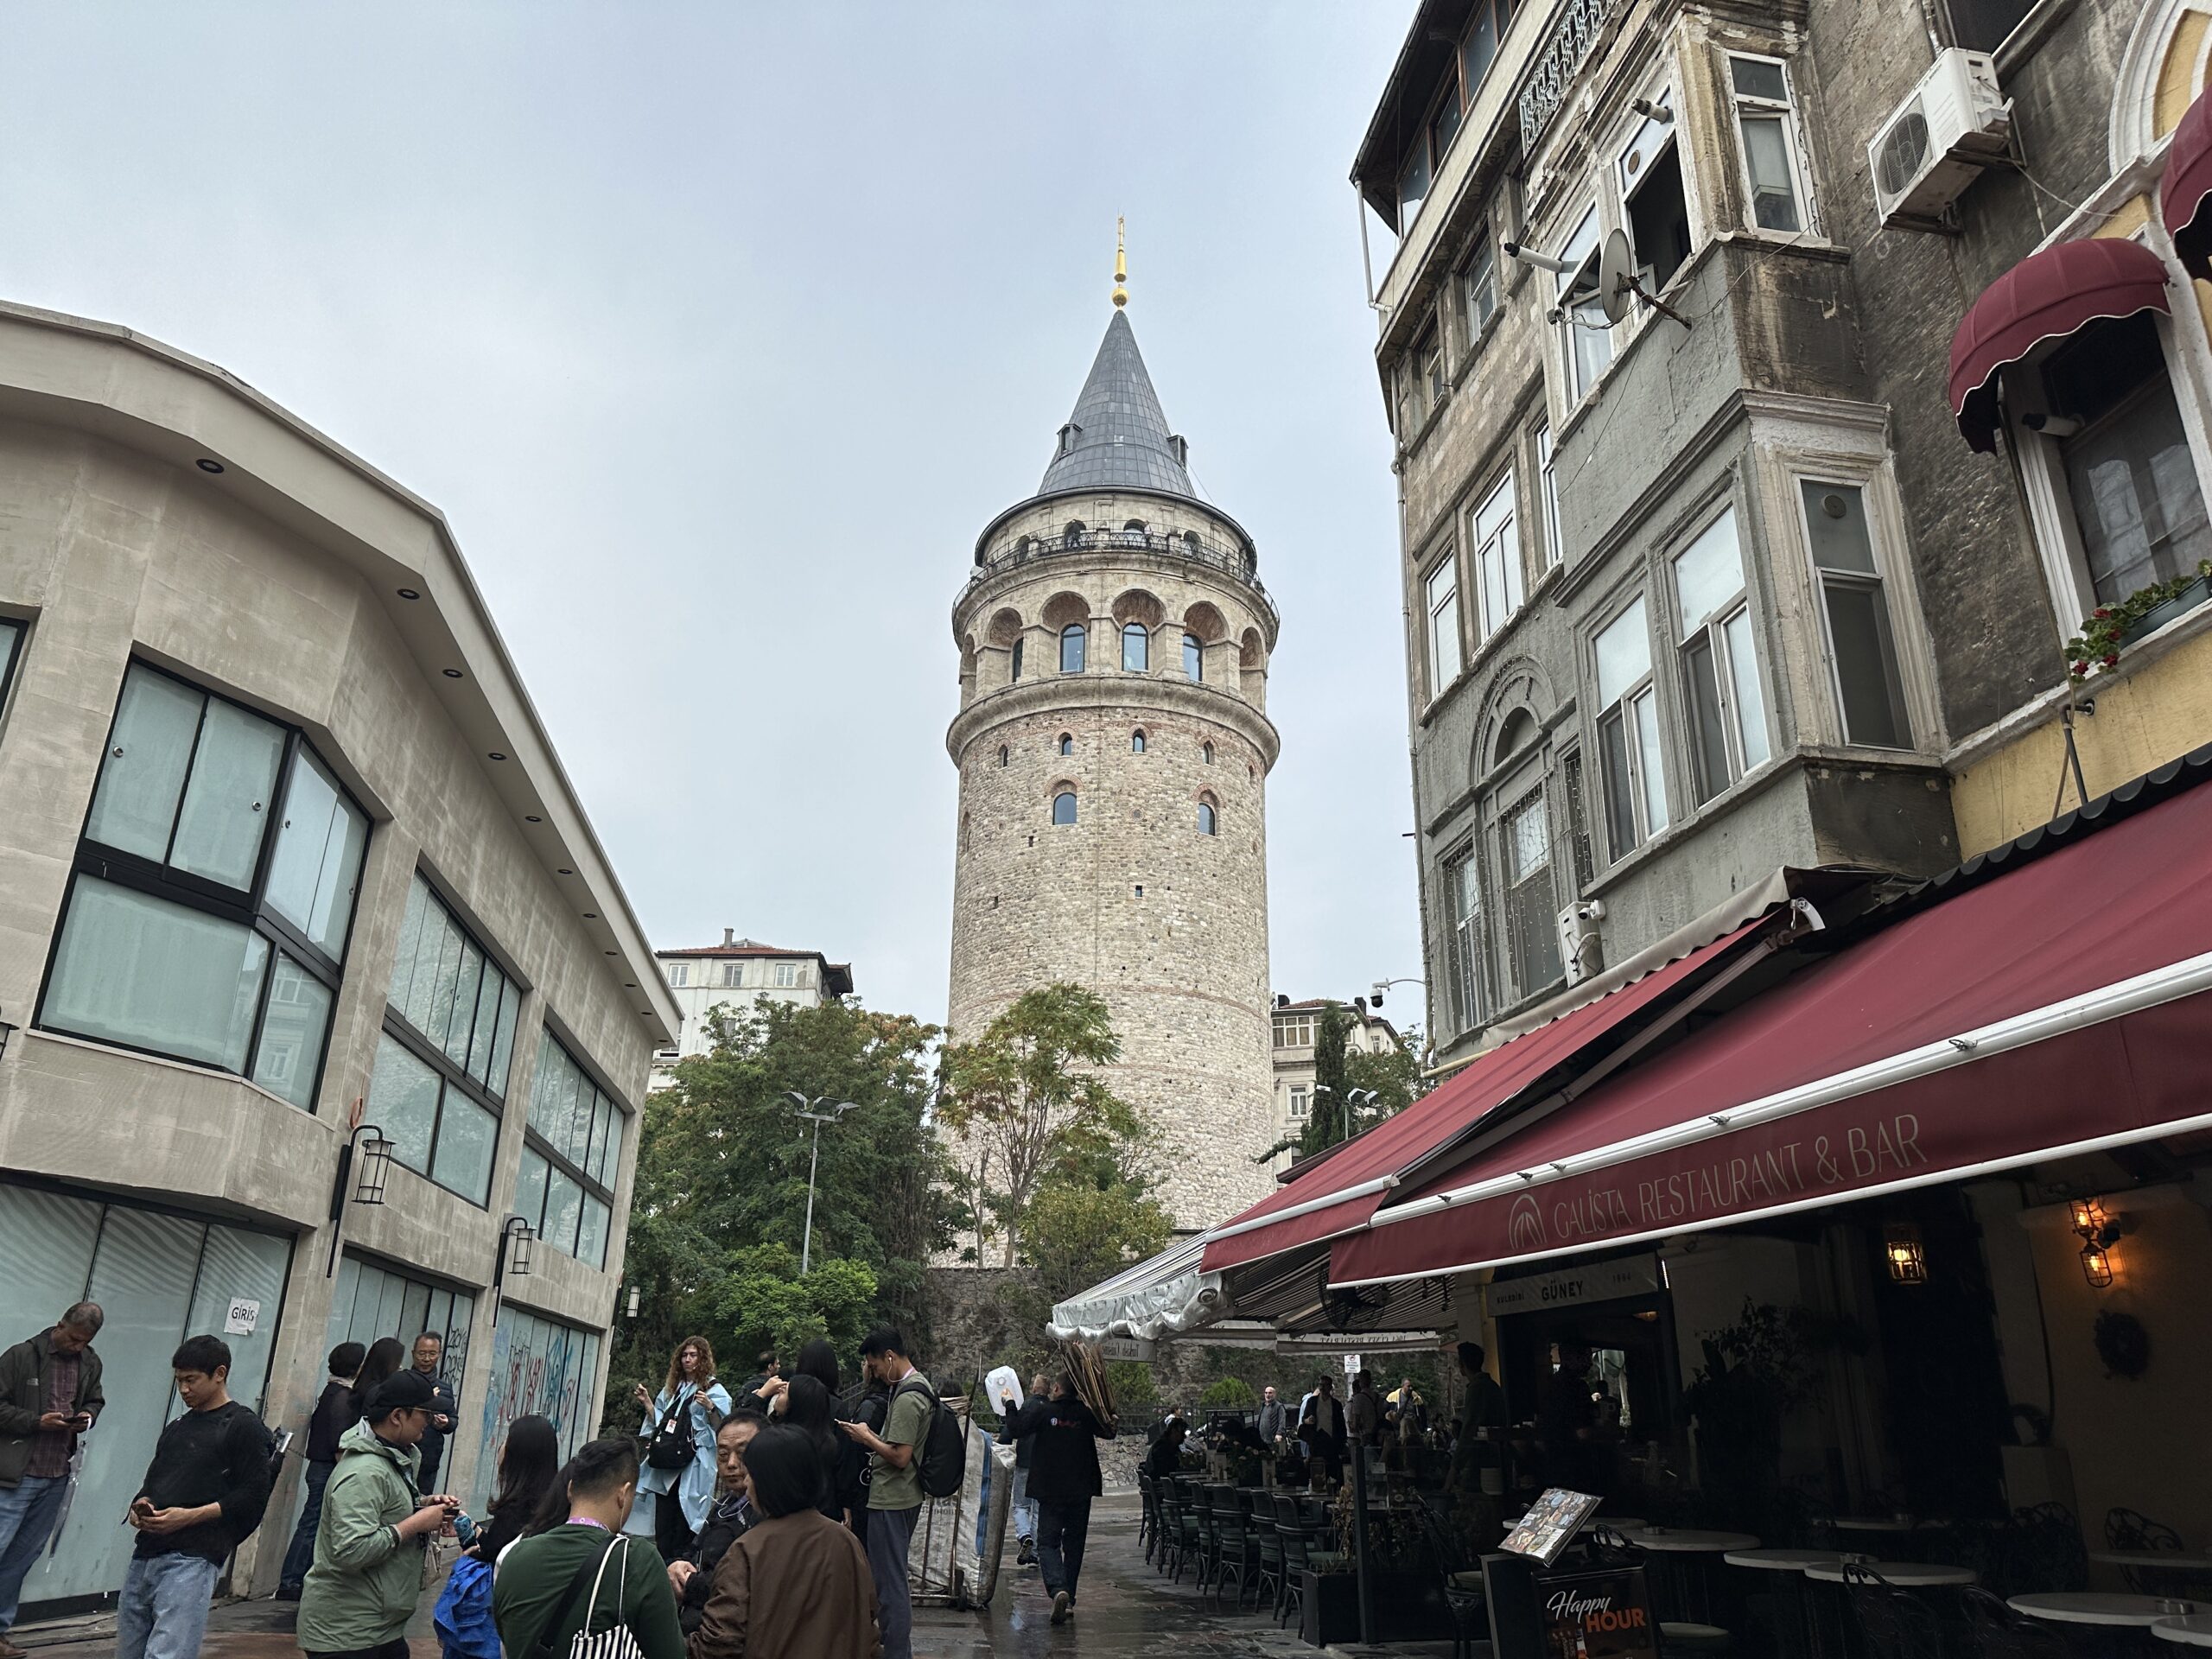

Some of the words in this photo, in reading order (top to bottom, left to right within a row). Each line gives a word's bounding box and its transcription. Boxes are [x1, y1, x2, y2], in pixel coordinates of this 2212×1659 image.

[1638, 1142, 1804, 1224] RESTAURANT
[1815, 1135, 1845, 1185] &
[1847, 1114, 1928, 1178] BAR
[1541, 1278, 1583, 1301] GÜNEY
[1547, 1590, 1611, 1624] Happy
[1586, 1607, 1646, 1633] HOUR
